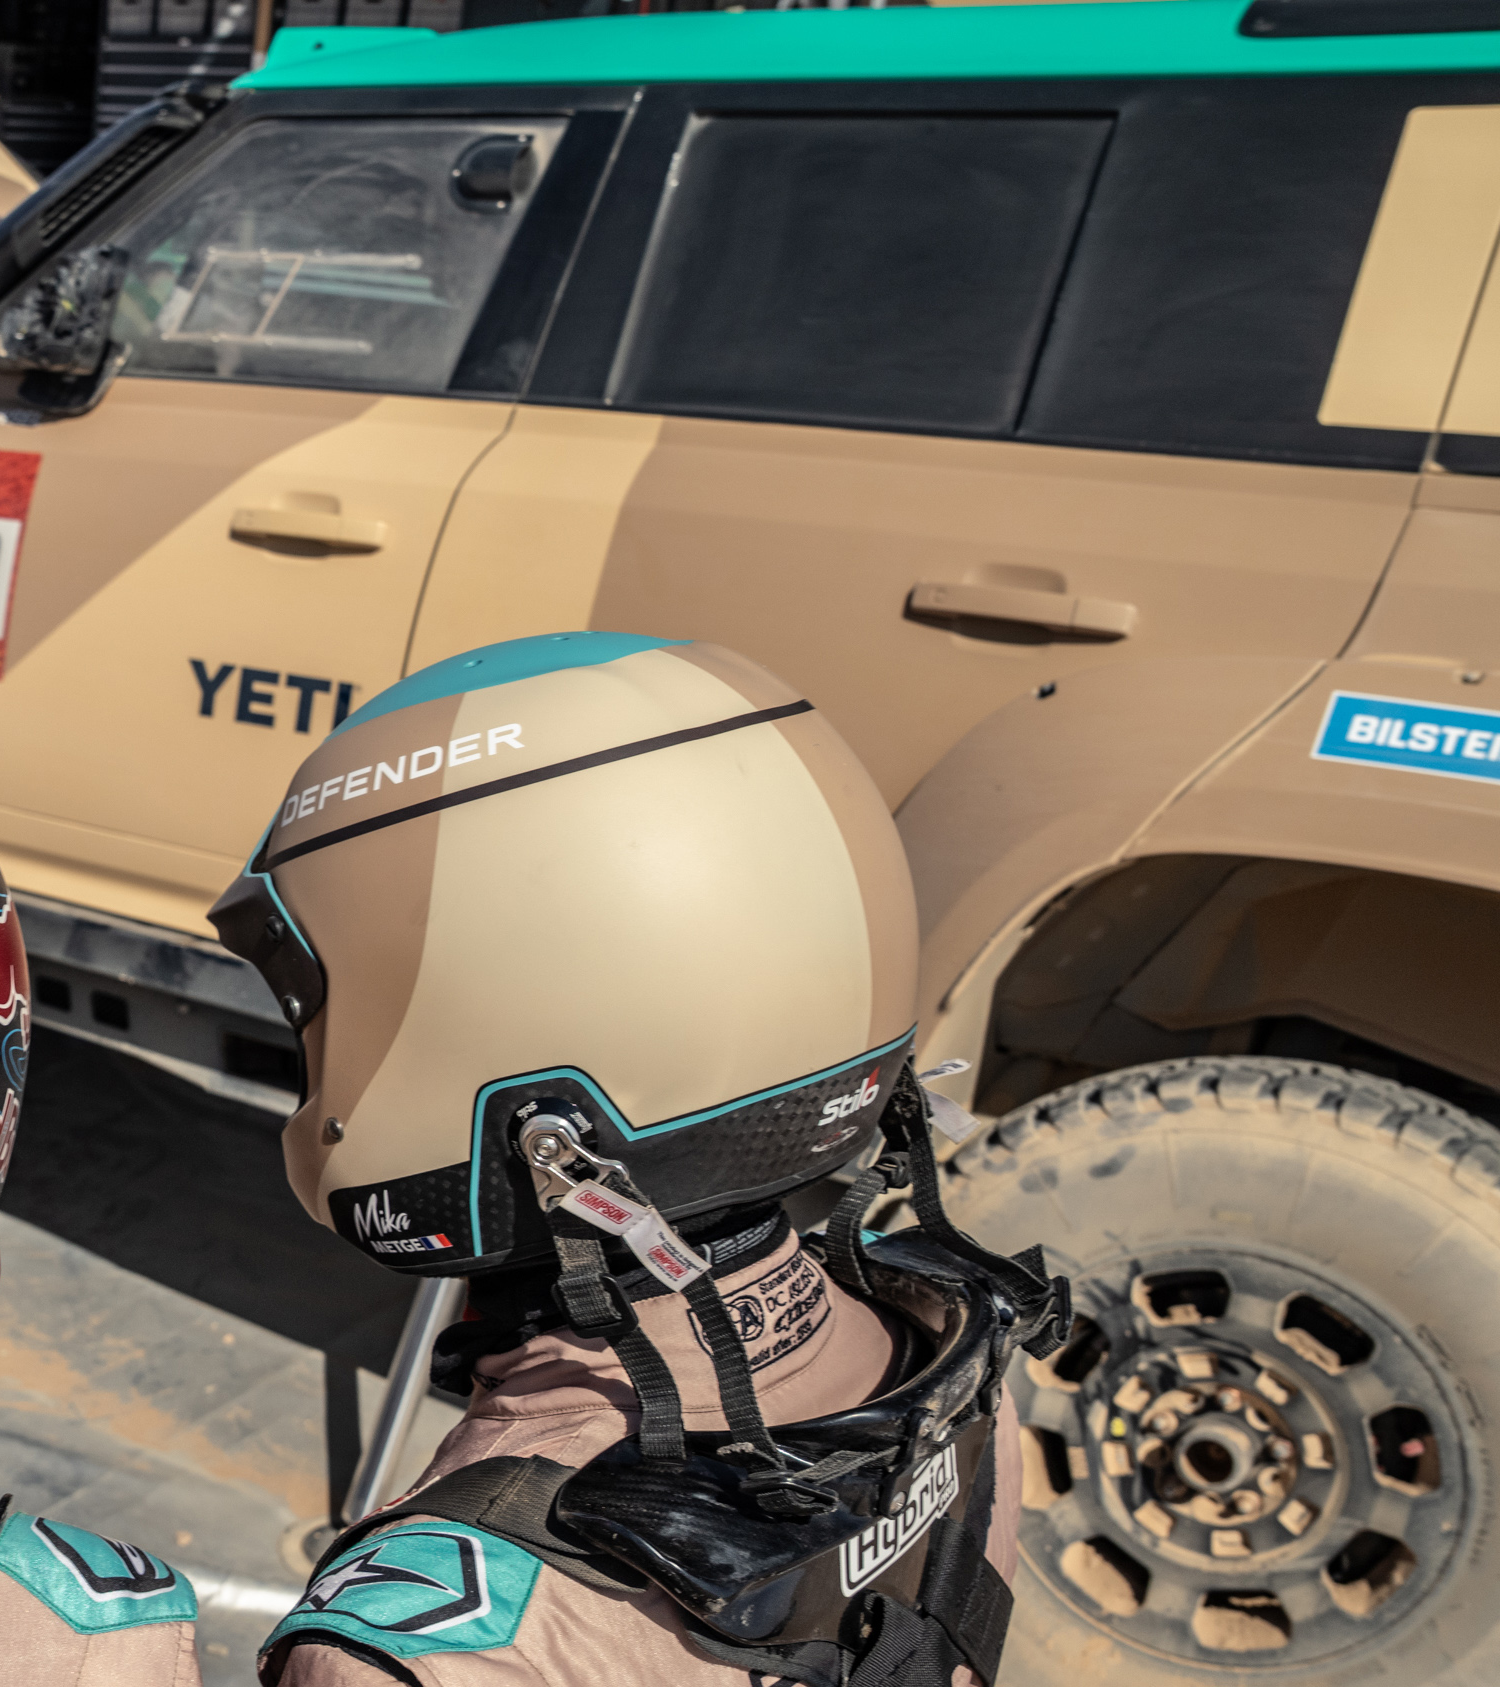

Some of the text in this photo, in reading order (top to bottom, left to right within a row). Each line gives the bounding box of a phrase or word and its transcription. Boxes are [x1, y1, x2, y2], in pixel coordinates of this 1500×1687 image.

[188, 657, 354, 735] YETI
[280, 722, 526, 828] DEFENDER
[353, 1189, 411, 1242] Mika
[579, 1191, 628, 1224] SIMPSON
[370, 1238, 426, 1254] METGE
[649, 1247, 685, 1276] SIMPSON
